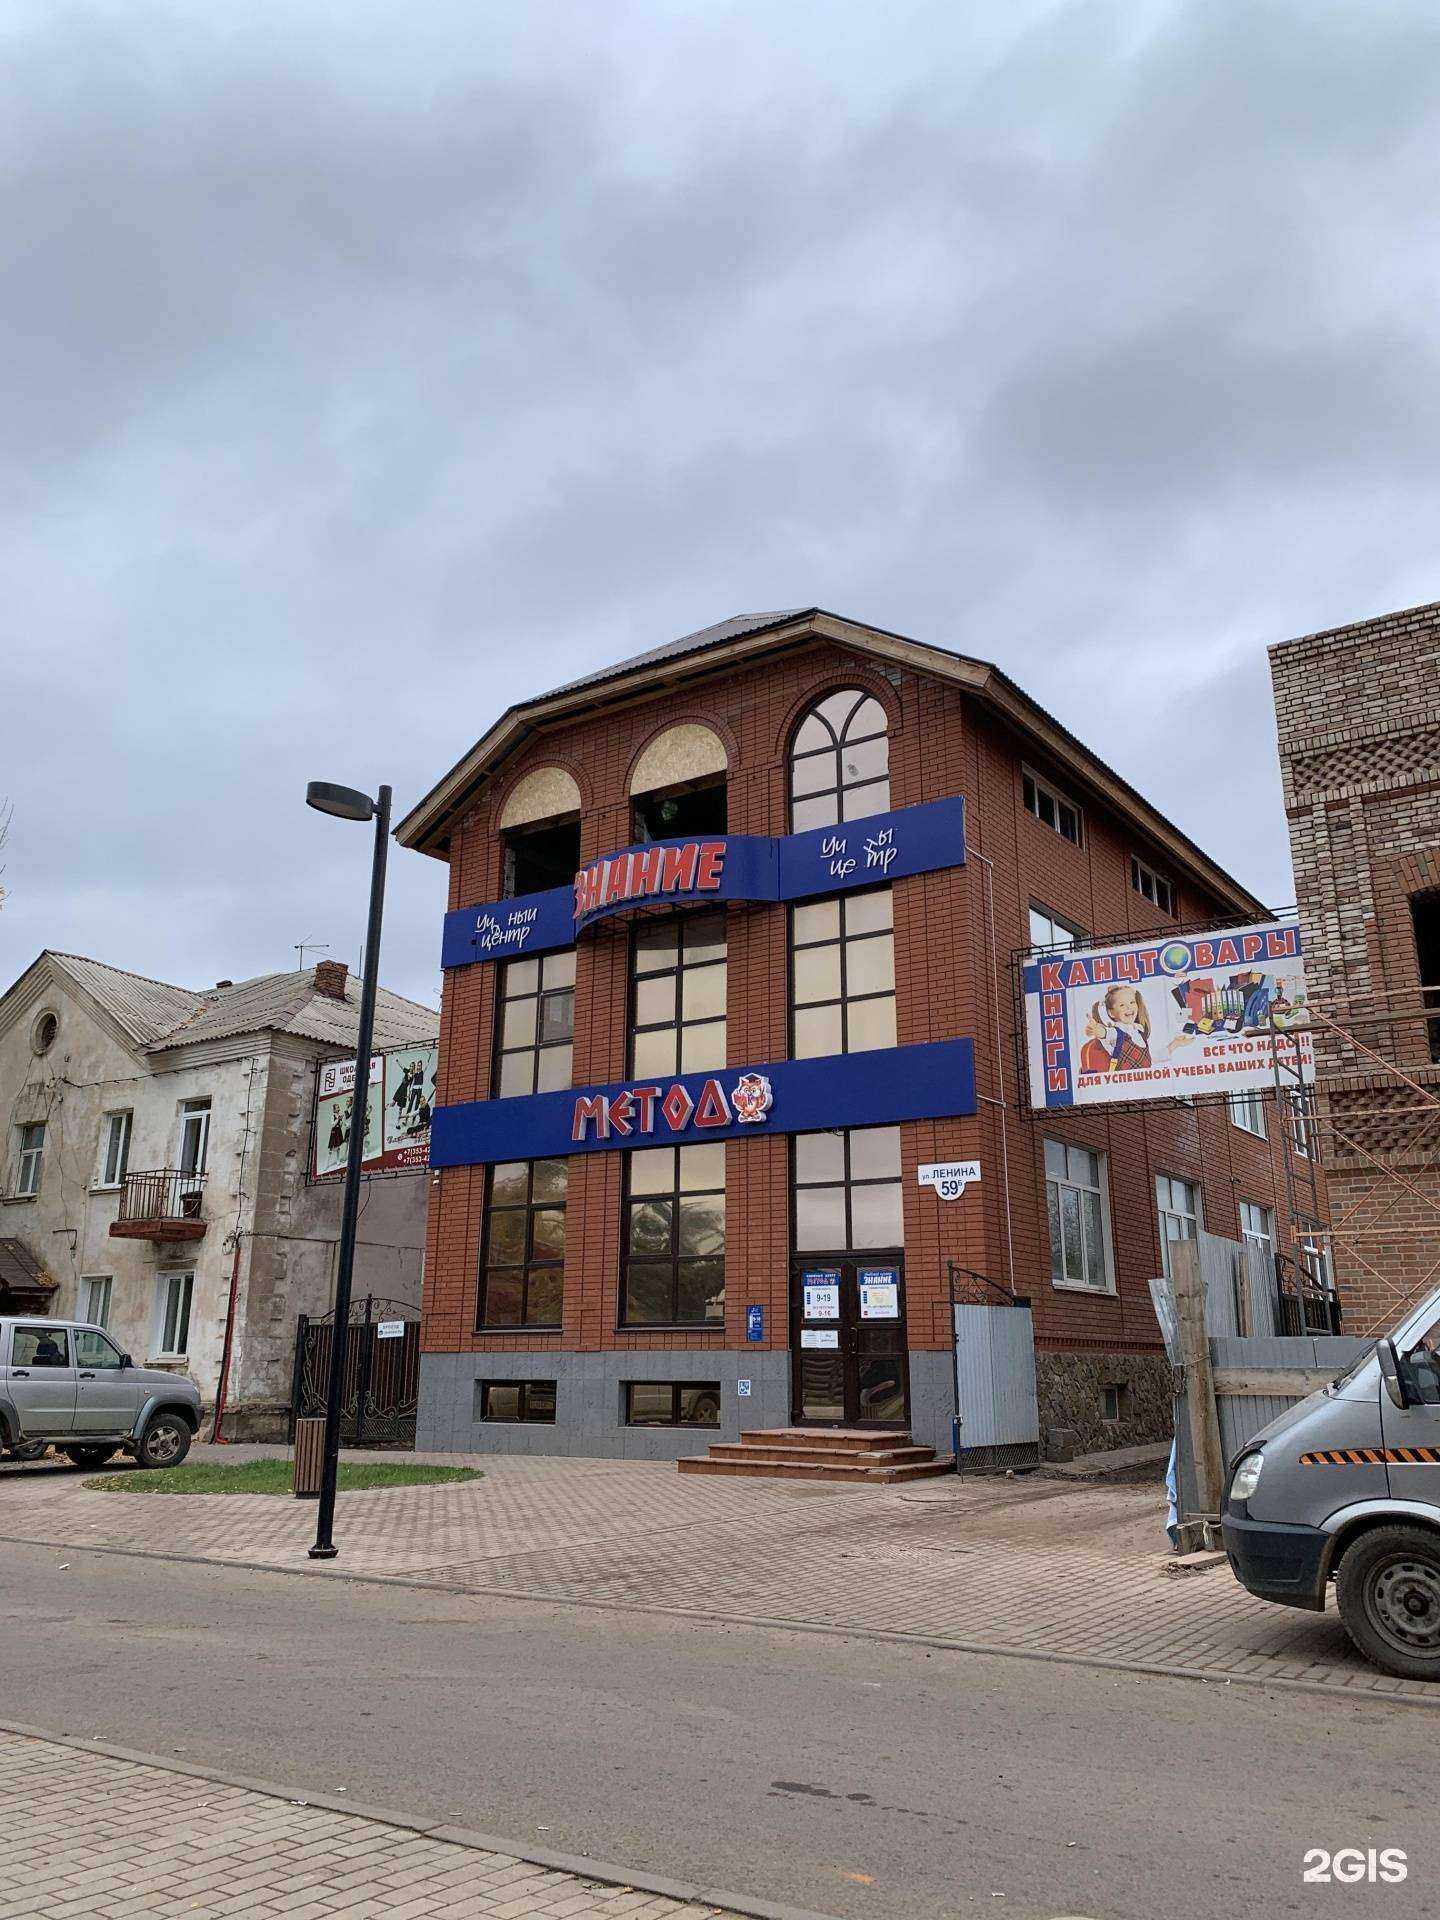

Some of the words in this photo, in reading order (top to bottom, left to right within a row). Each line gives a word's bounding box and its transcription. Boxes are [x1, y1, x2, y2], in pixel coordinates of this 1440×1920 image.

[573, 842, 727, 919] ЗНАНИЕ
[1203, 1045, 1226, 1058] ВСЕ
[1228, 1042, 1254, 1054] ЧТО
[1077, 1076, 1101, 1089] ДЛЯ
[1103, 1067, 1171, 1084] УСПЕШНОЙ
[1173, 1063, 1216, 1078] УЧЕБЫ
[1218, 1058, 1266, 1073] ВАШИХ
[571, 1079, 733, 1141] МЕТОД
[932, 1166, 976, 1179] ЛЕНИНА
